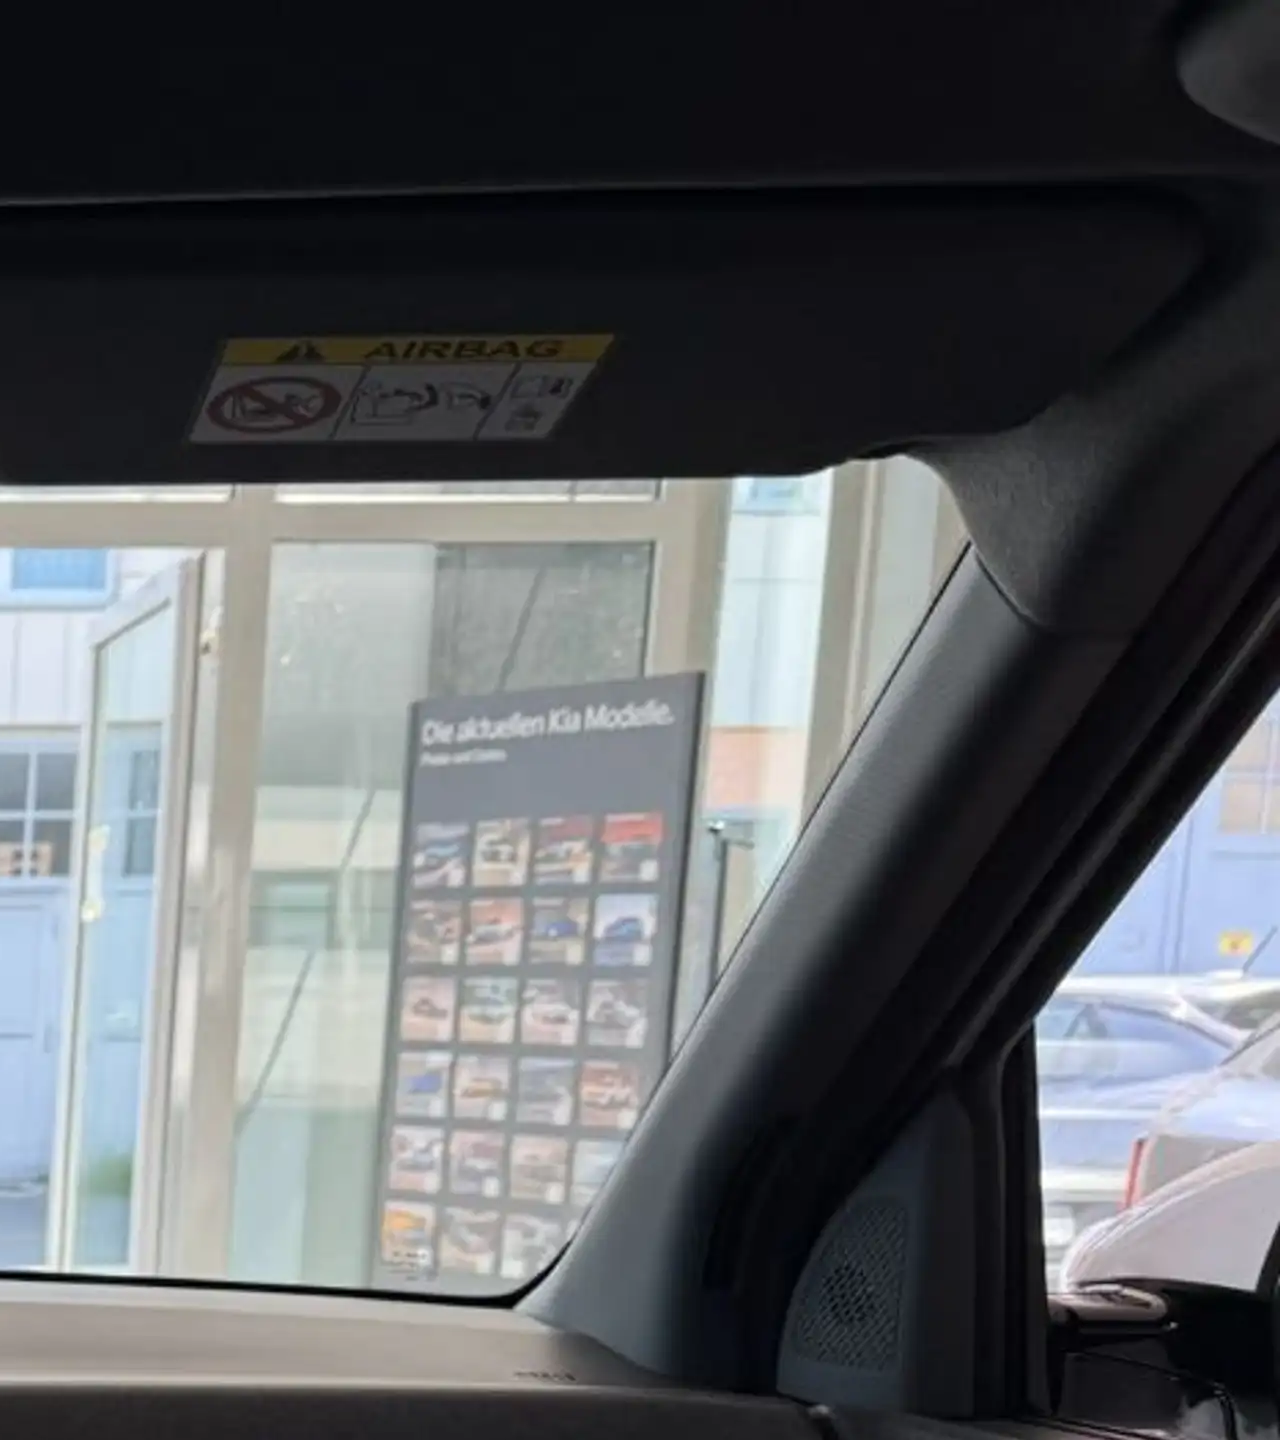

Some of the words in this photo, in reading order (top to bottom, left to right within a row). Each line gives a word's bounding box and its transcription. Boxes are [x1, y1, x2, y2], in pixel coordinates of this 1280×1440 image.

[364, 339, 564, 360] AIRBAG
[421, 719, 453, 746] Die
[456, 712, 546, 743] aktuellen
[547, 706, 582, 735] Kia
[584, 699, 676, 732] Modelle.
